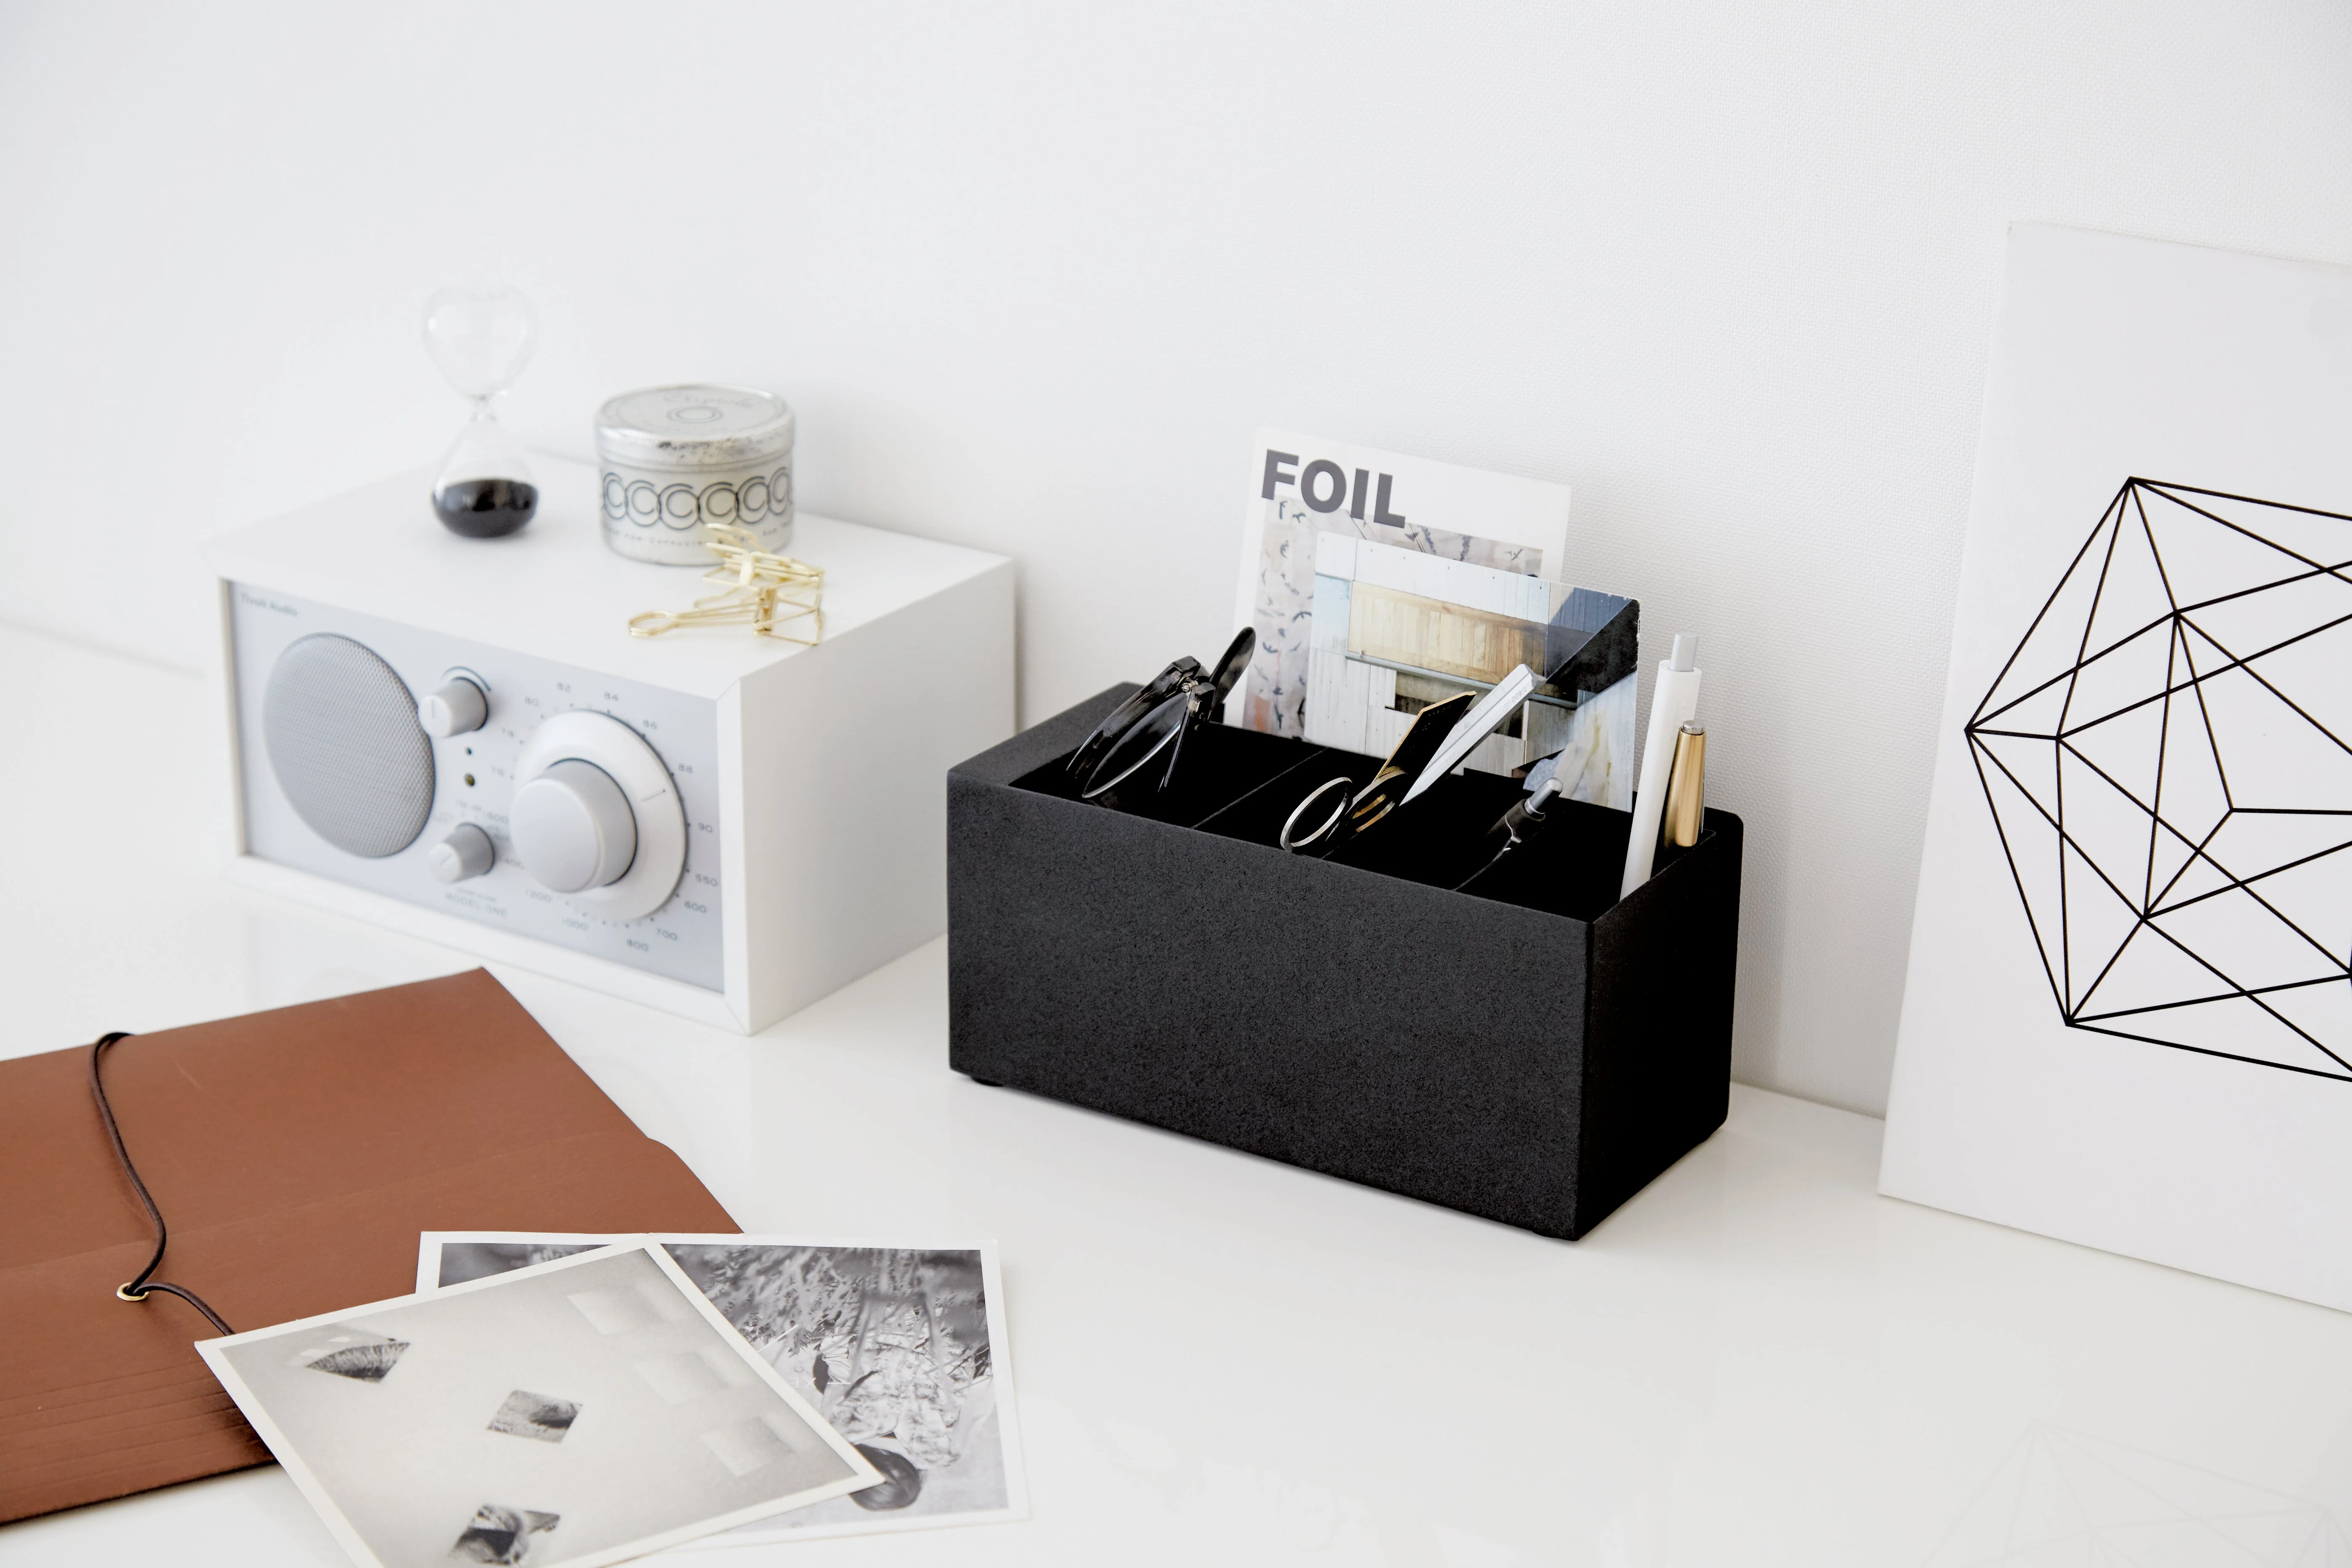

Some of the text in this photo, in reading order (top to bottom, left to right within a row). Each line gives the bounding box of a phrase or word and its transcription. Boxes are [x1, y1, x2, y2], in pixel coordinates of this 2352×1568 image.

[1261, 449, 1406, 528] FOIL
[557, 682, 571, 692] 82
[525, 697, 539, 707] 80
[604, 692, 619, 702] 84
[643, 719, 657, 730] 86
[678, 764, 693, 774] 88
[697, 823, 713, 833] 90
[696, 874, 717, 886] 550
[684, 901, 706, 913] 600
[562, 917, 588, 931] 1000
[656, 929, 677, 941] 700
[627, 940, 649, 952] 800
